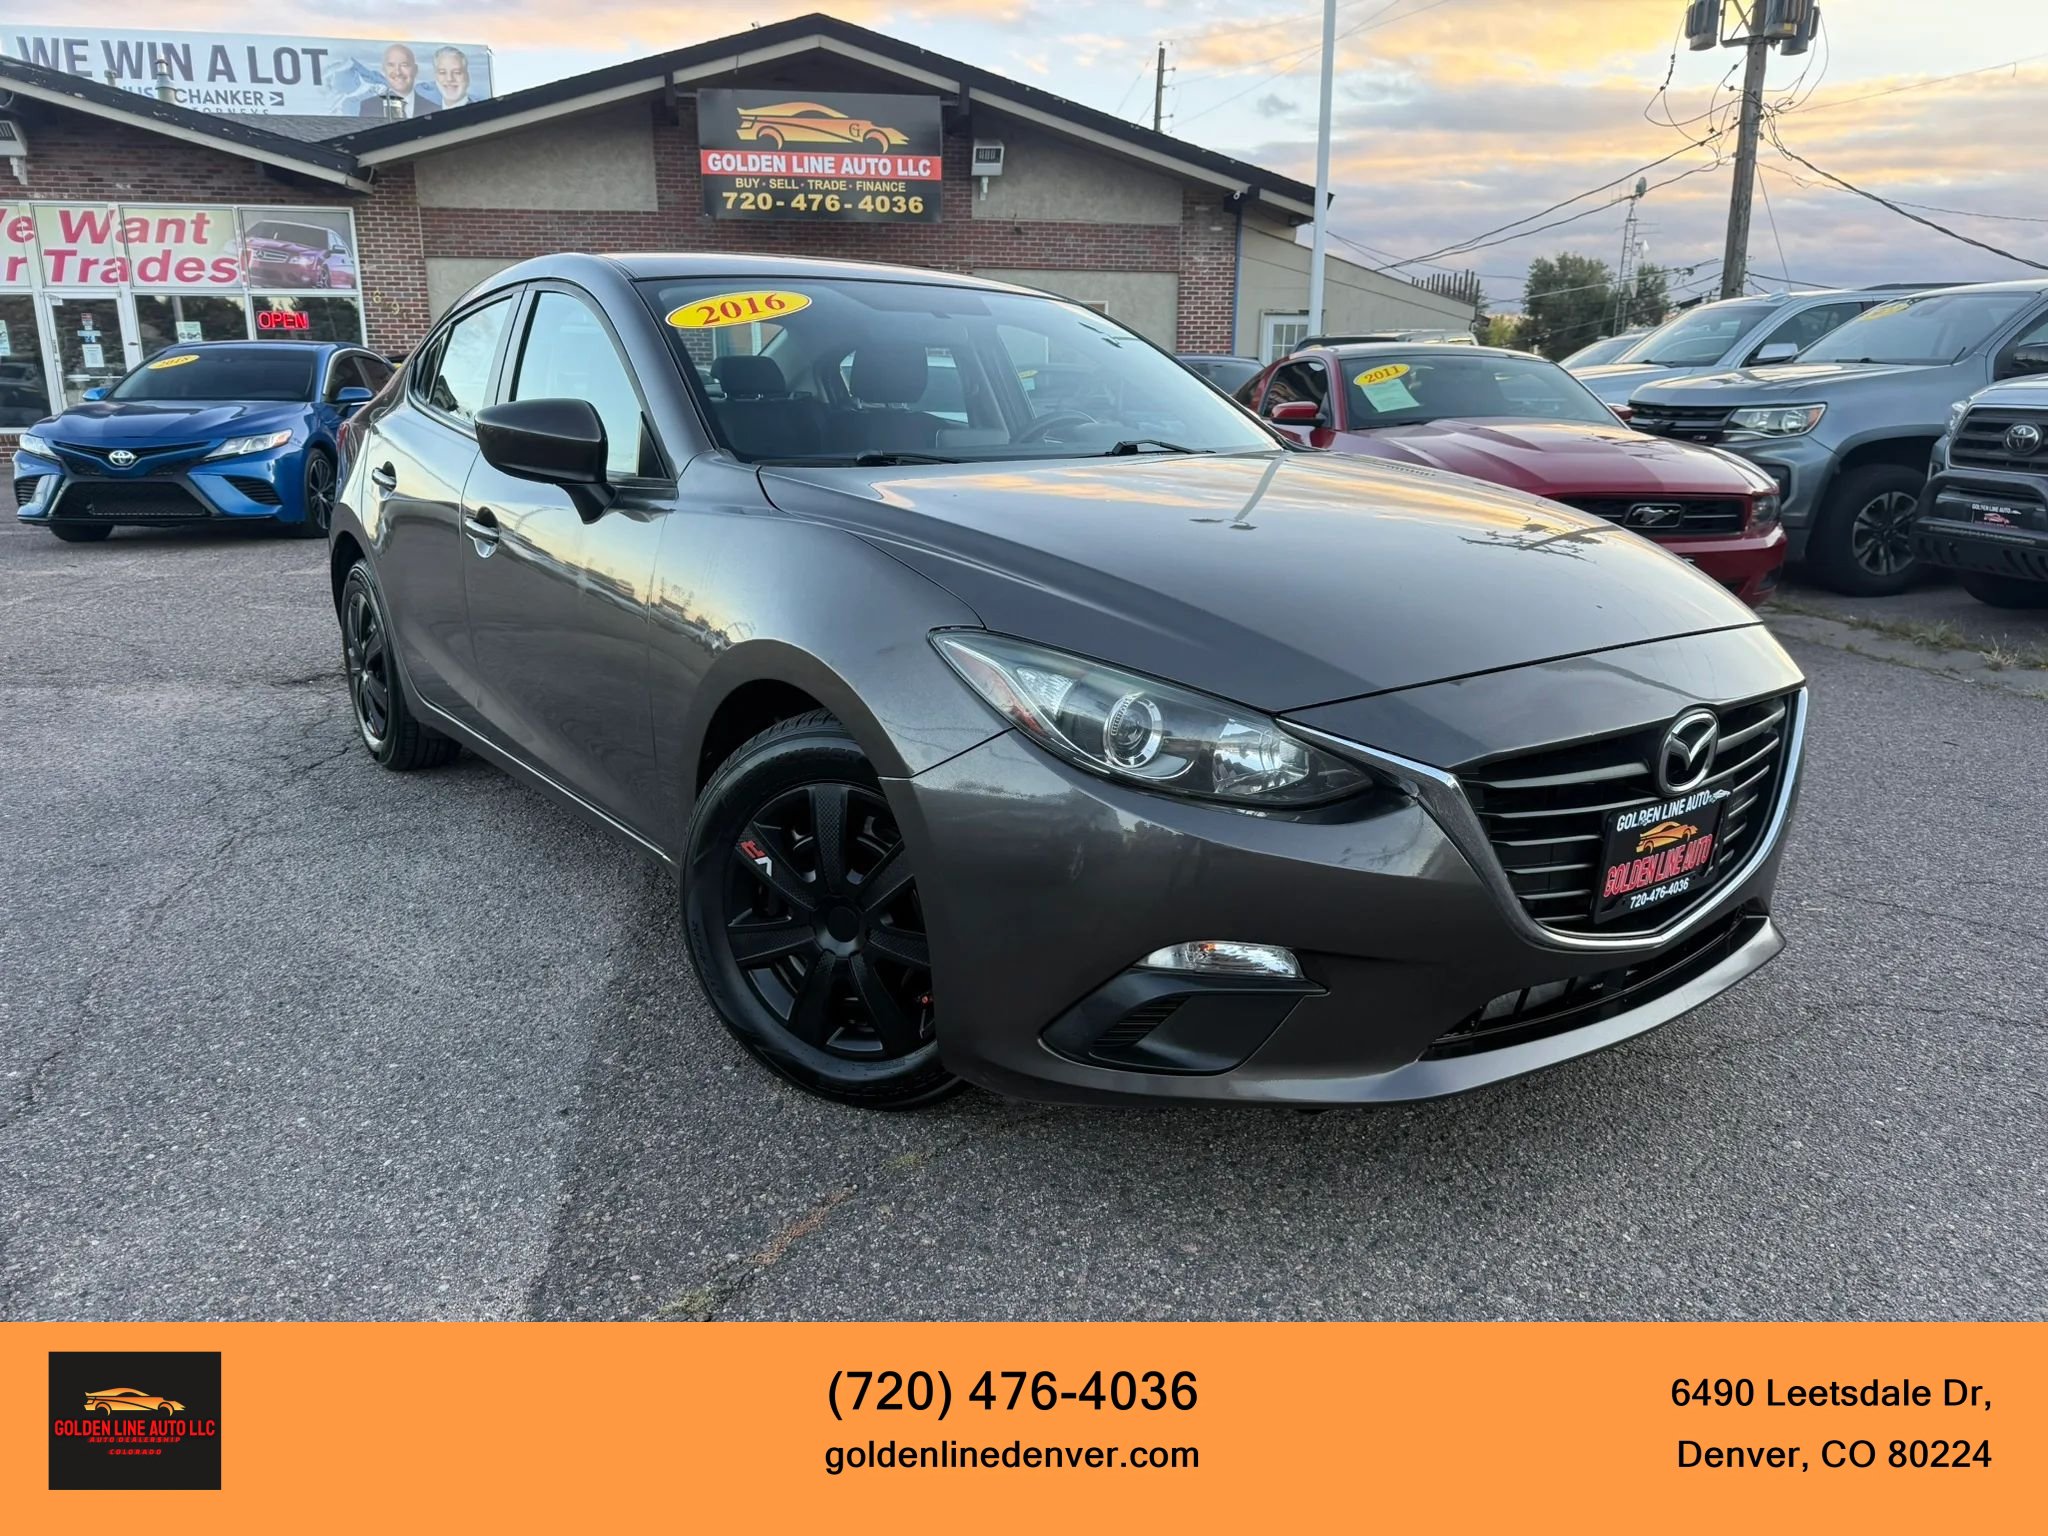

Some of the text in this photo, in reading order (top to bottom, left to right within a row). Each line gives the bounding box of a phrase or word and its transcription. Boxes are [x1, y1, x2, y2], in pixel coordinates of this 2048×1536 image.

[16, 36, 328, 86] WE WIN A LOT
[173, 88, 265, 106] CHANKER
[707, 152, 931, 177] GOLDEN LINE AUTO LLC
[735, 177, 906, 193] BUY SELL TRADE FINANCE
[58, 208, 211, 244] Want
[258, 312, 309, 329] OPEN
[696, 293, 786, 325] 2016
[1364, 365, 1400, 383] 2011
[1616, 790, 1710, 832] GOLDEN LINE AUTO
[1603, 834, 1713, 897] GOLDEN LINE AUTO
[1629, 877, 1690, 909] 720-476-4036
